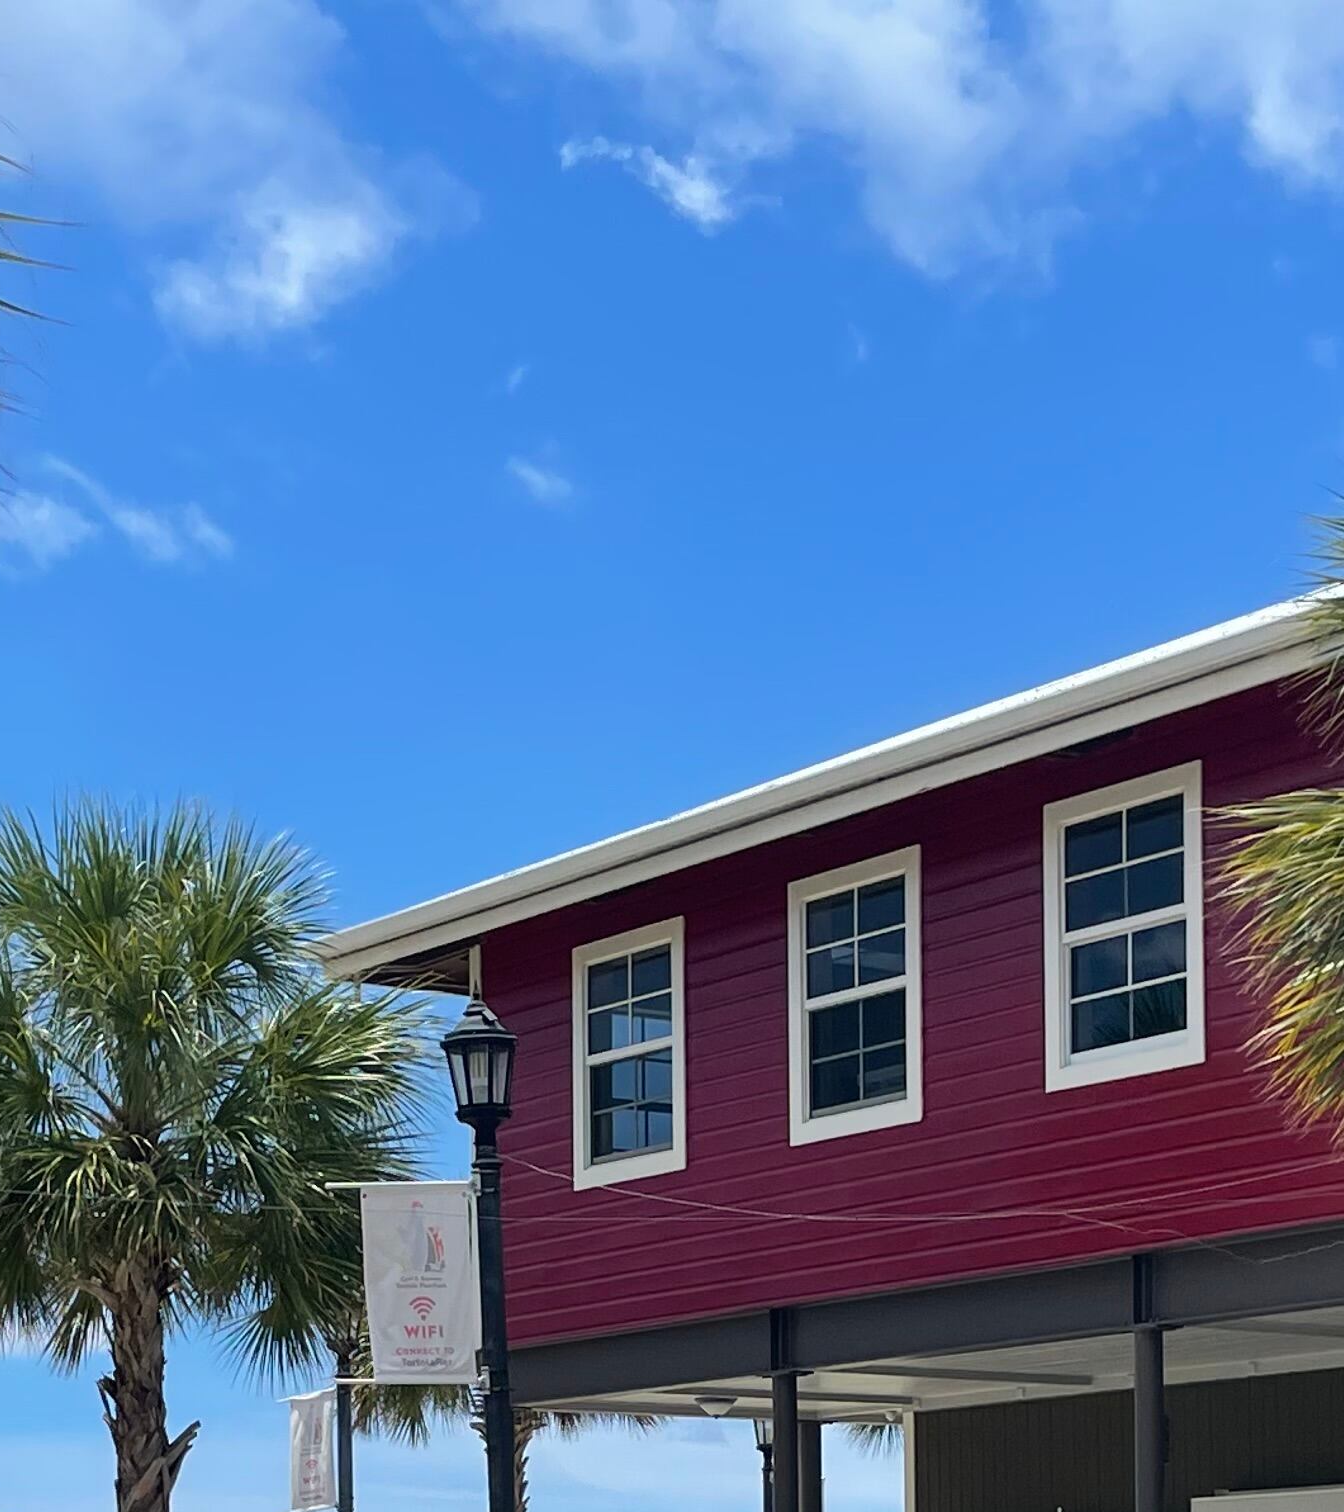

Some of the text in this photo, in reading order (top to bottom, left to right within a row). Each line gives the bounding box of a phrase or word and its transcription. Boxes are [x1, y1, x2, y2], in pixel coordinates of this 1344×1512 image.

[404, 1325, 444, 1339] WIFI
[396, 1346, 455, 1355] CONNECT TO
